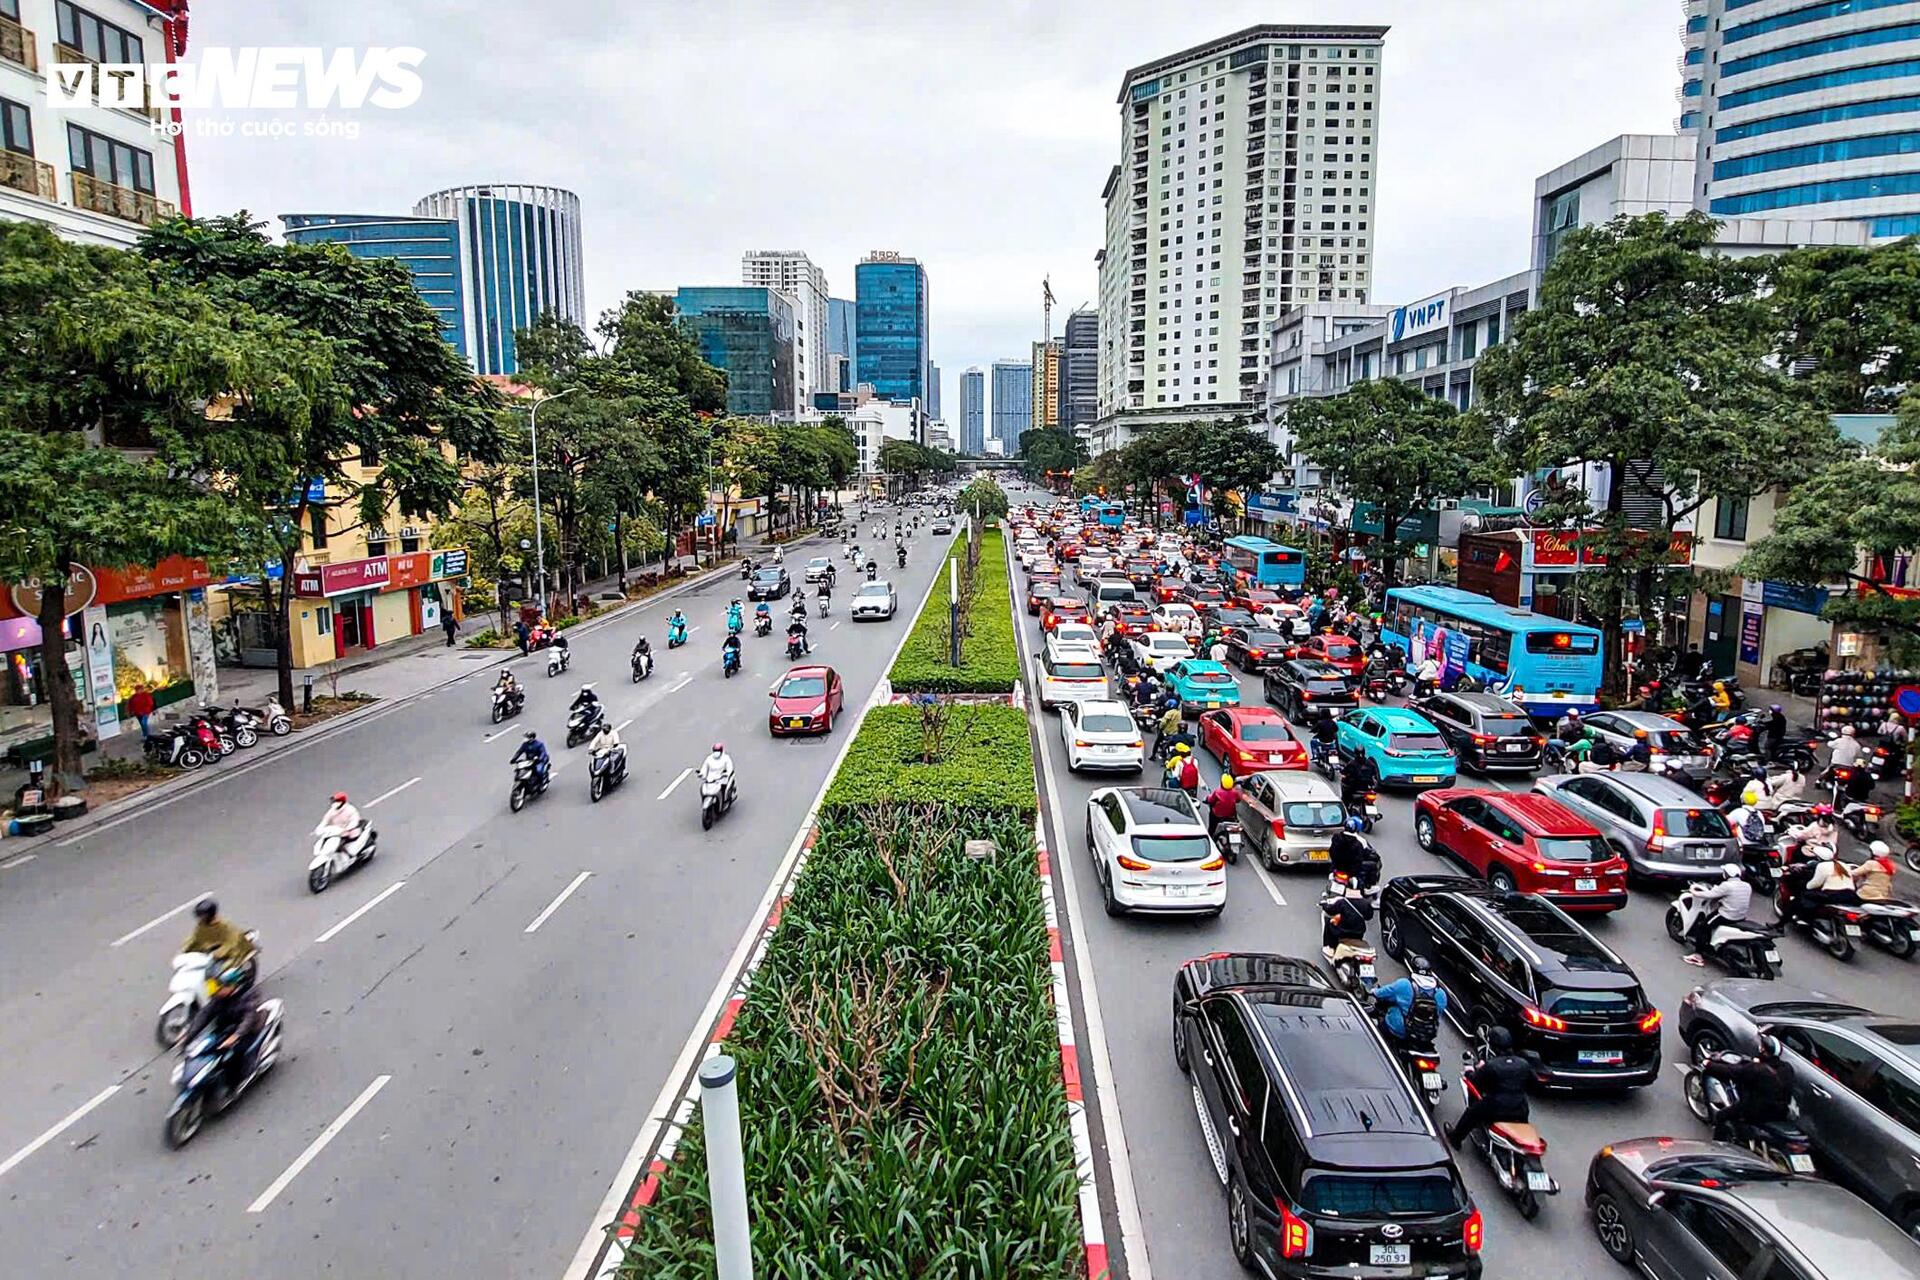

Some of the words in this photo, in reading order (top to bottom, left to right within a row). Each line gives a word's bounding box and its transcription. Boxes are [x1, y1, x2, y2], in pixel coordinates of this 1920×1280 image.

[1409, 300, 1444, 328] VNPT
[363, 561, 387, 578] ATM
[301, 580, 319, 591] ATM
[1382, 1245, 1398, 1254] 30L
